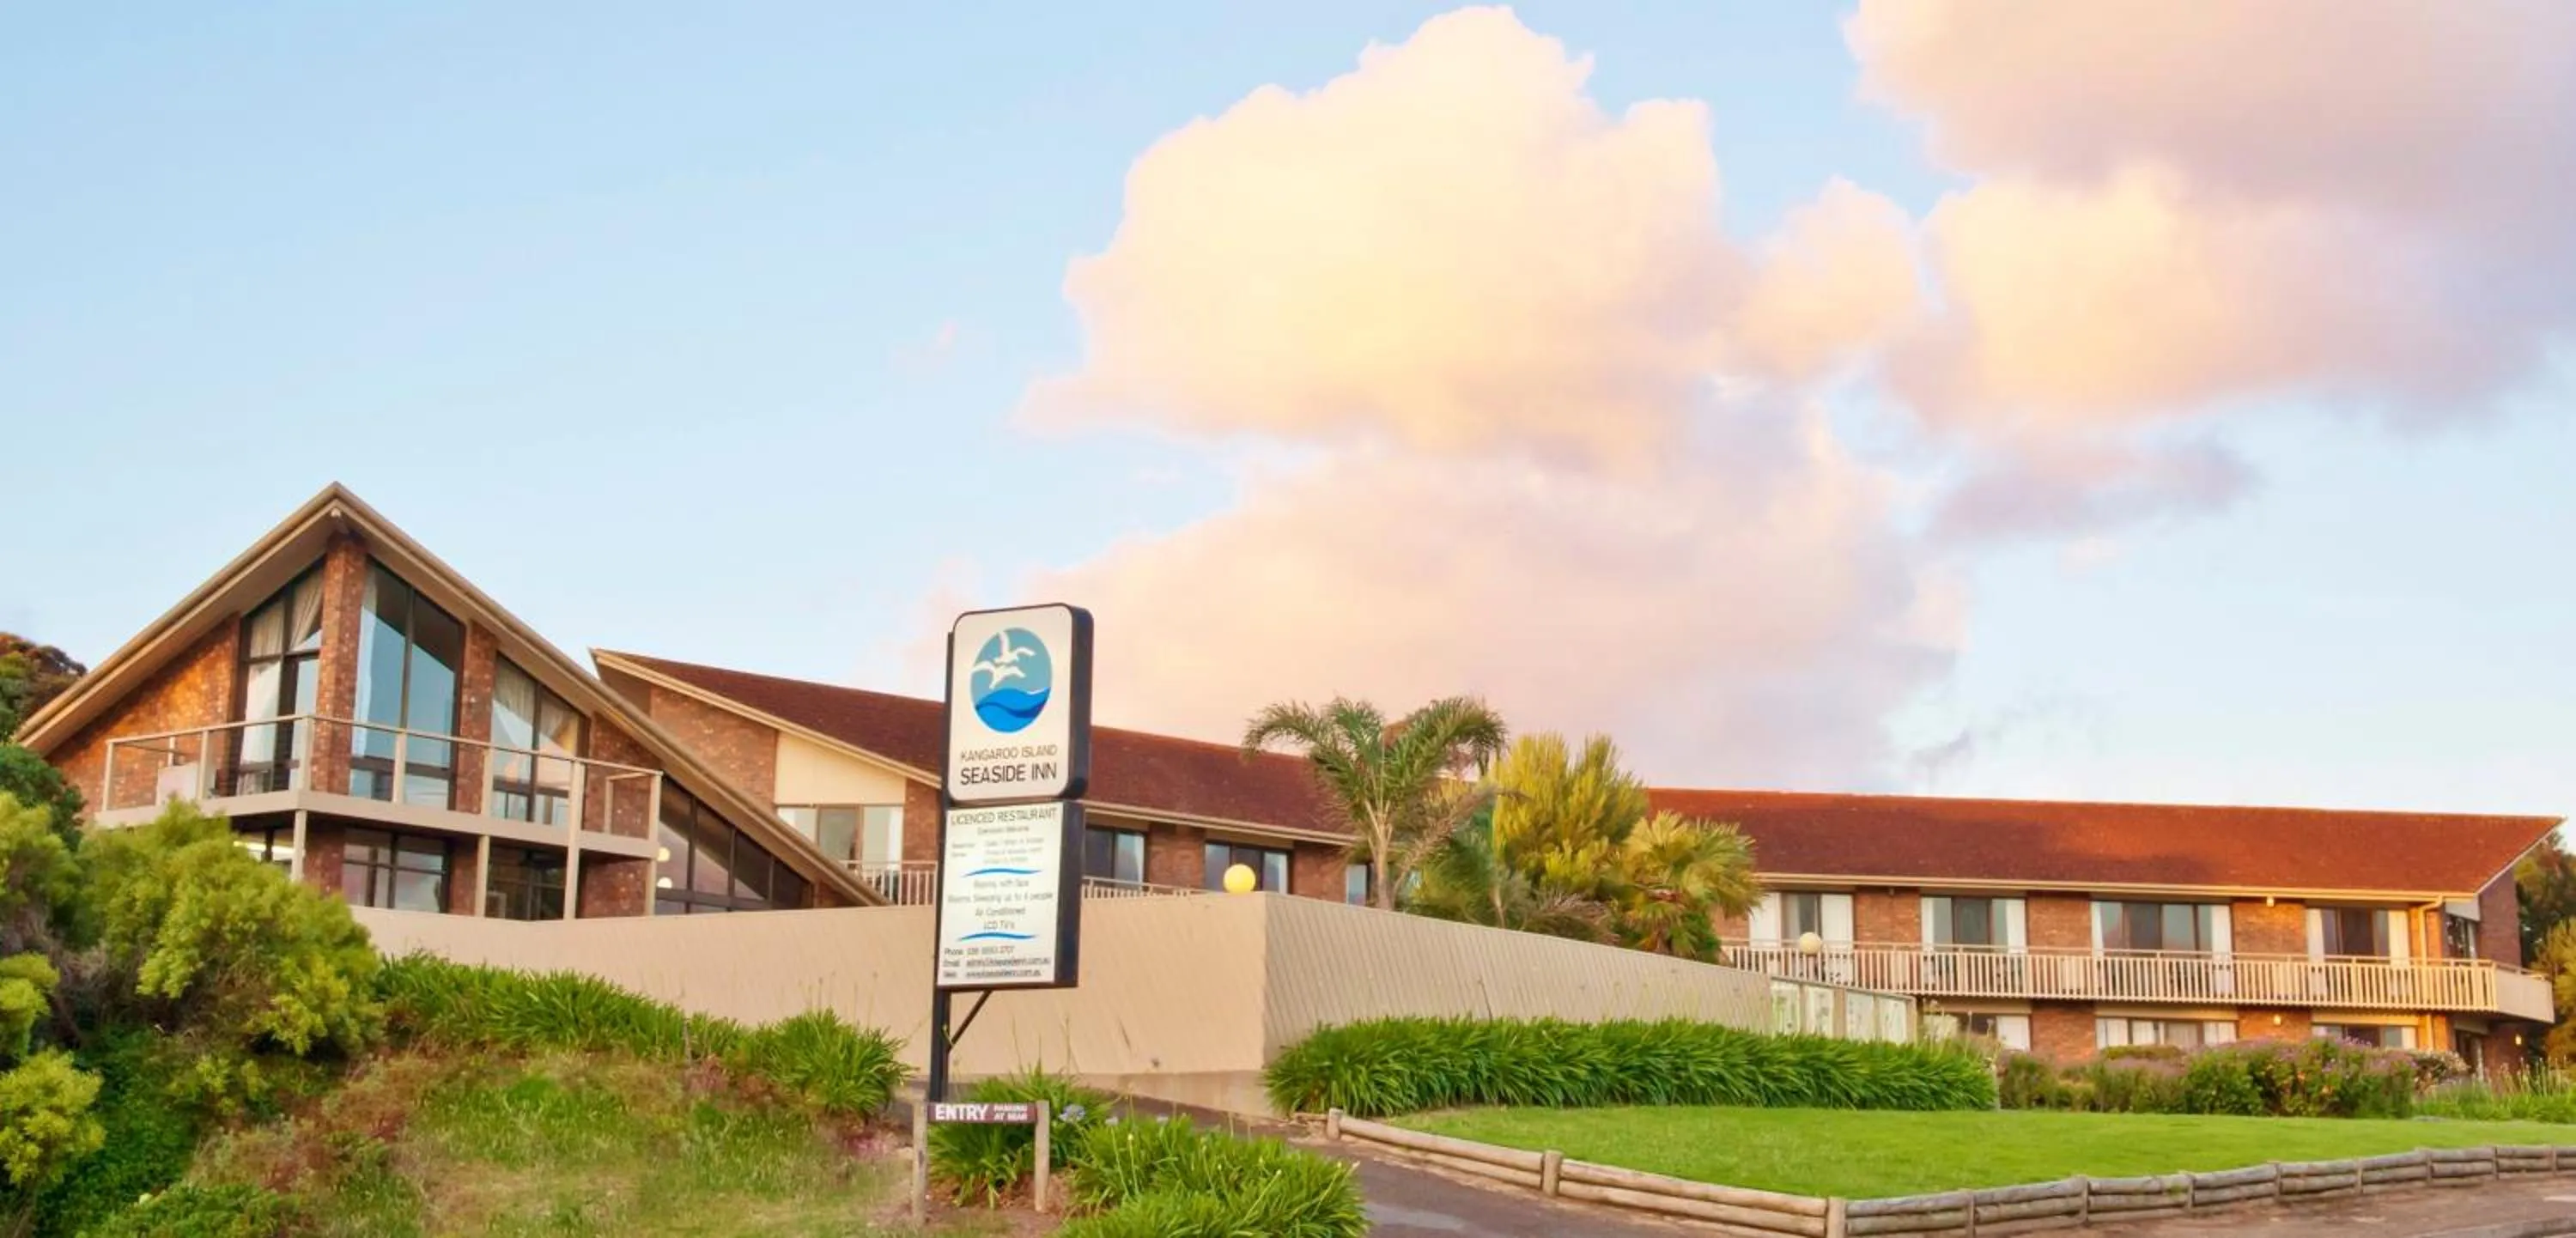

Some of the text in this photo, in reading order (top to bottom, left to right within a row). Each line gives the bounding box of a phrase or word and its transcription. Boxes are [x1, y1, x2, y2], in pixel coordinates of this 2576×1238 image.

[960, 744, 1058, 762] KANGAROO ISLAND
[960, 762, 1057, 785] SEASIDE INN
[951, 807, 1057, 825] LICENCED RESTAURANT
[986, 907, 1026, 916] Conditioned
[984, 919, 998, 929] LCD
[944, 947, 964, 956] Phone
[935, 1103, 989, 1120] ENTRY
[994, 1112, 1028, 1120] AT REAR
